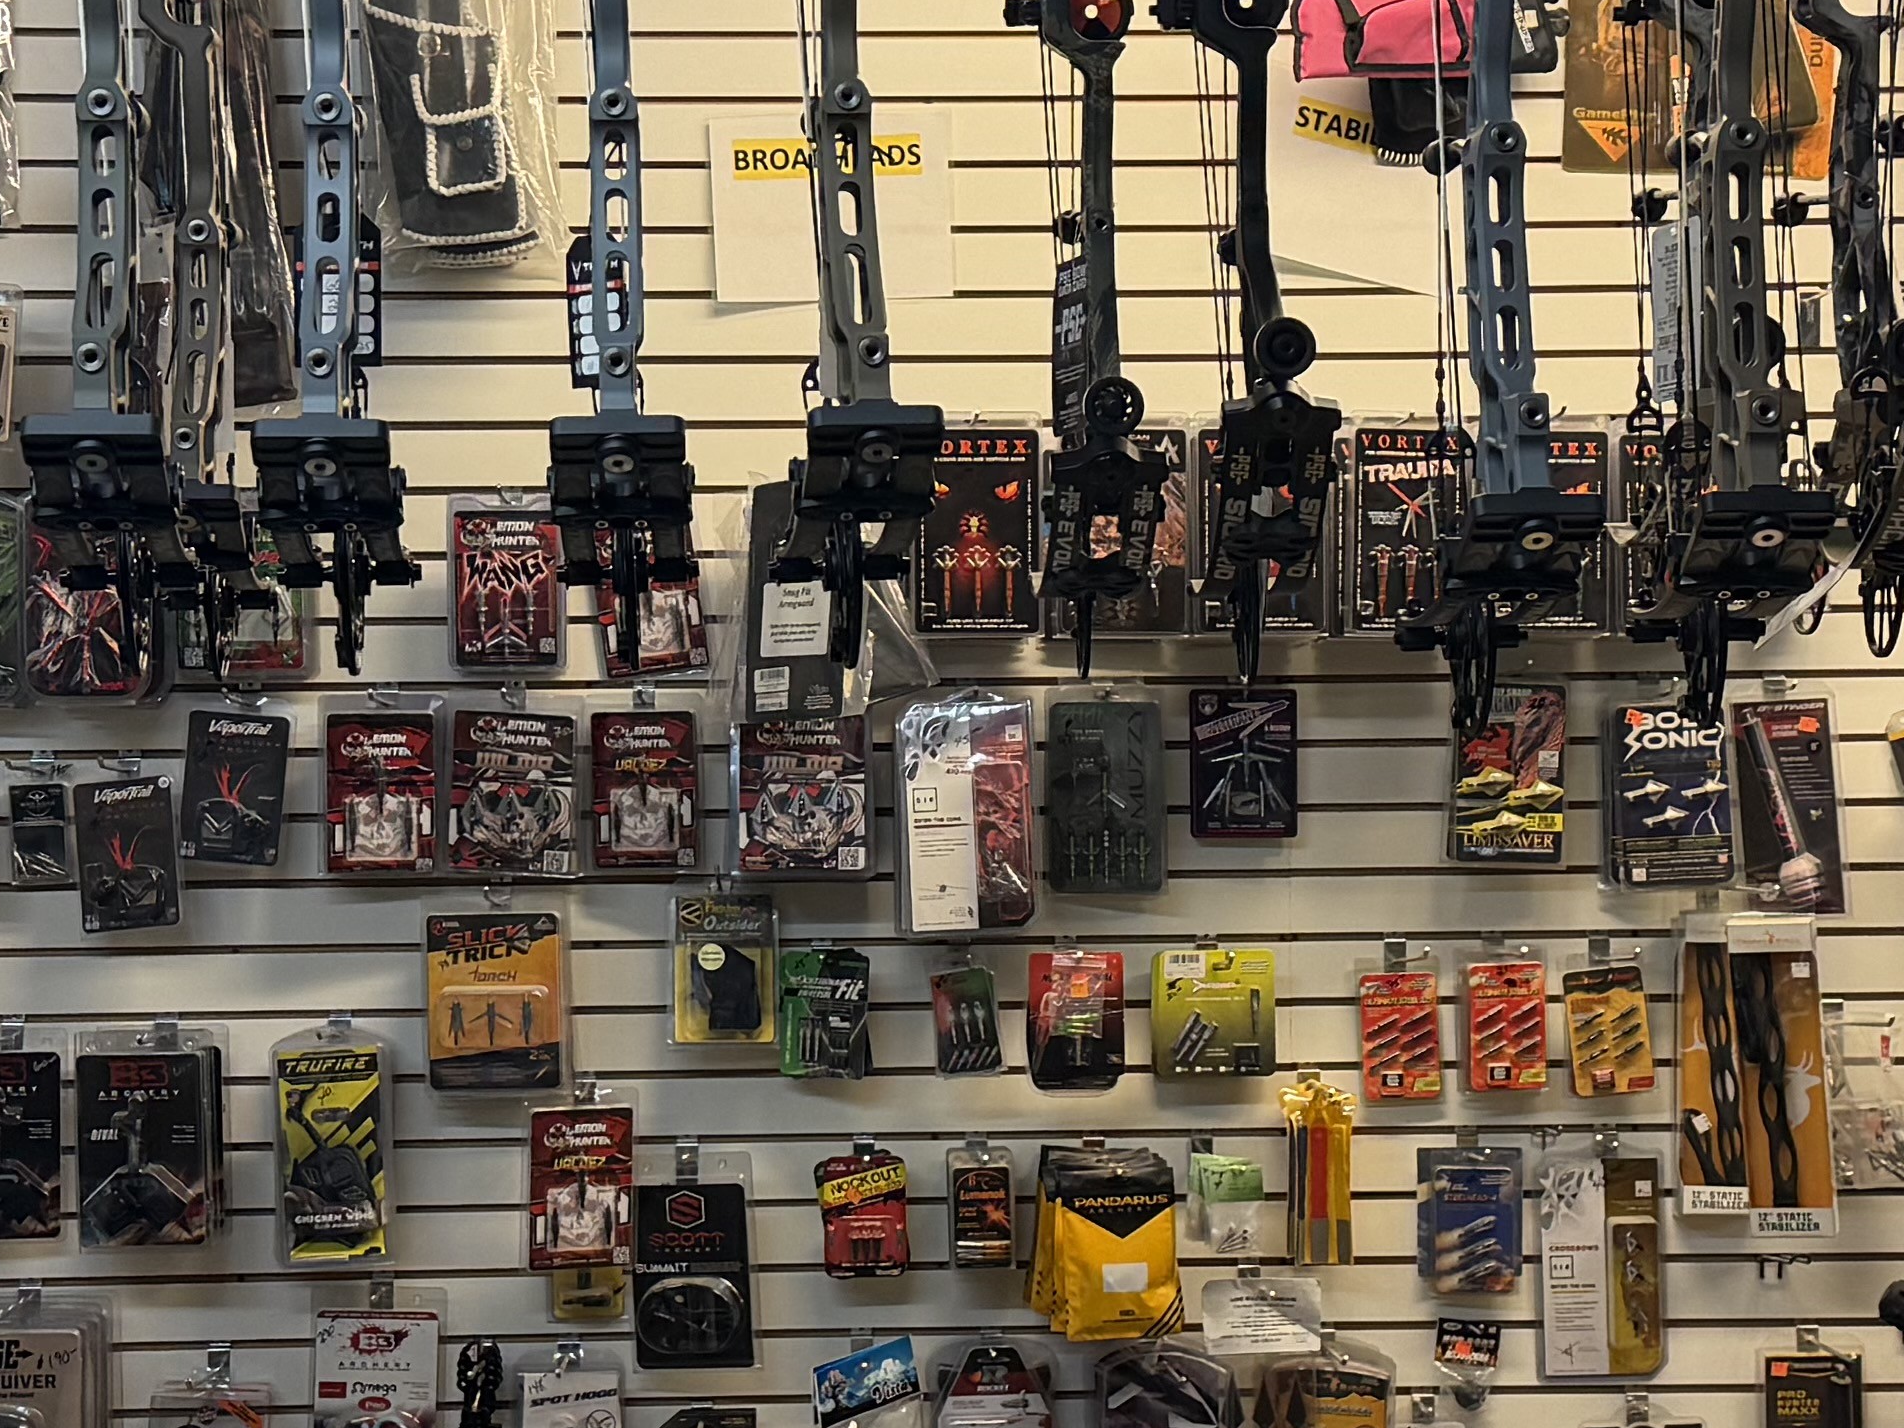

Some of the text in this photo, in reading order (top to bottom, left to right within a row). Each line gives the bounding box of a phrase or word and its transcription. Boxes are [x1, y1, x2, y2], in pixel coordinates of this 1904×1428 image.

[940, 439, 1029, 454] ORTEX
[1361, 434, 1459, 451] VORTX
[1622, 727, 1719, 762] SONIC
[703, 914, 763, 931] Outsider
[446, 941, 530, 966] TRICK
[285, 1056, 370, 1074] TRUFIRE
[830, 1165, 902, 1197] NOCKOUT
[1074, 1194, 1169, 1209] PANDARUS
[1709, 1190, 1744, 1201] STATIC
[1691, 1200, 1750, 1210] STABILIZER
[1776, 1212, 1813, 1222] STATIC
[1758, 1221, 1820, 1232] STABILIZER
[649, 1232, 725, 1247] SCOTT
[529, 1393, 573, 1409] SPOT
